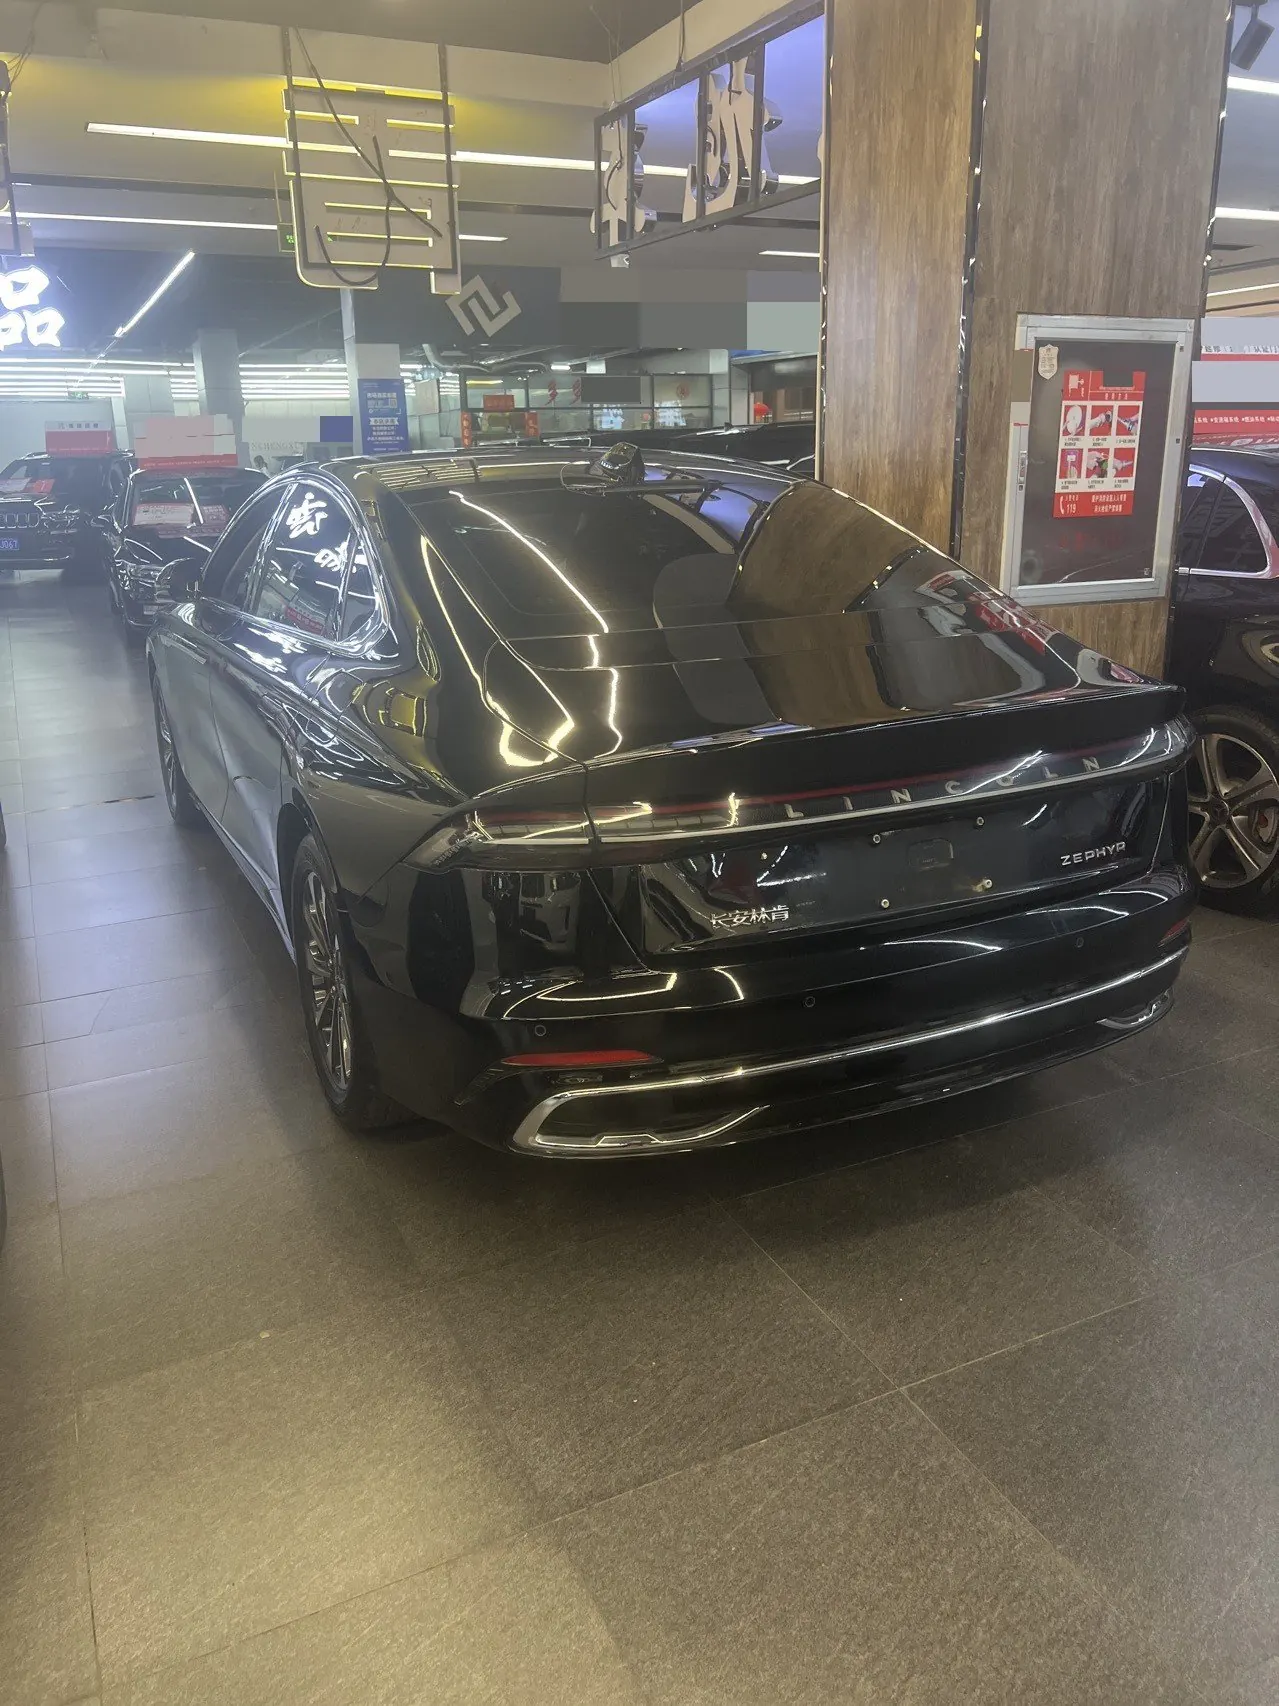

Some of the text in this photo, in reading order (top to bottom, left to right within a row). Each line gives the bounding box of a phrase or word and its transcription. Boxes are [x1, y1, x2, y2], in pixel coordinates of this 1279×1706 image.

[1066, 503, 1077, 514] 119
[783, 756, 1101, 819] LINCOLN
[1060, 840, 1127, 867] ZEPHYR
[710, 905, 790, 929] 长安林肯
